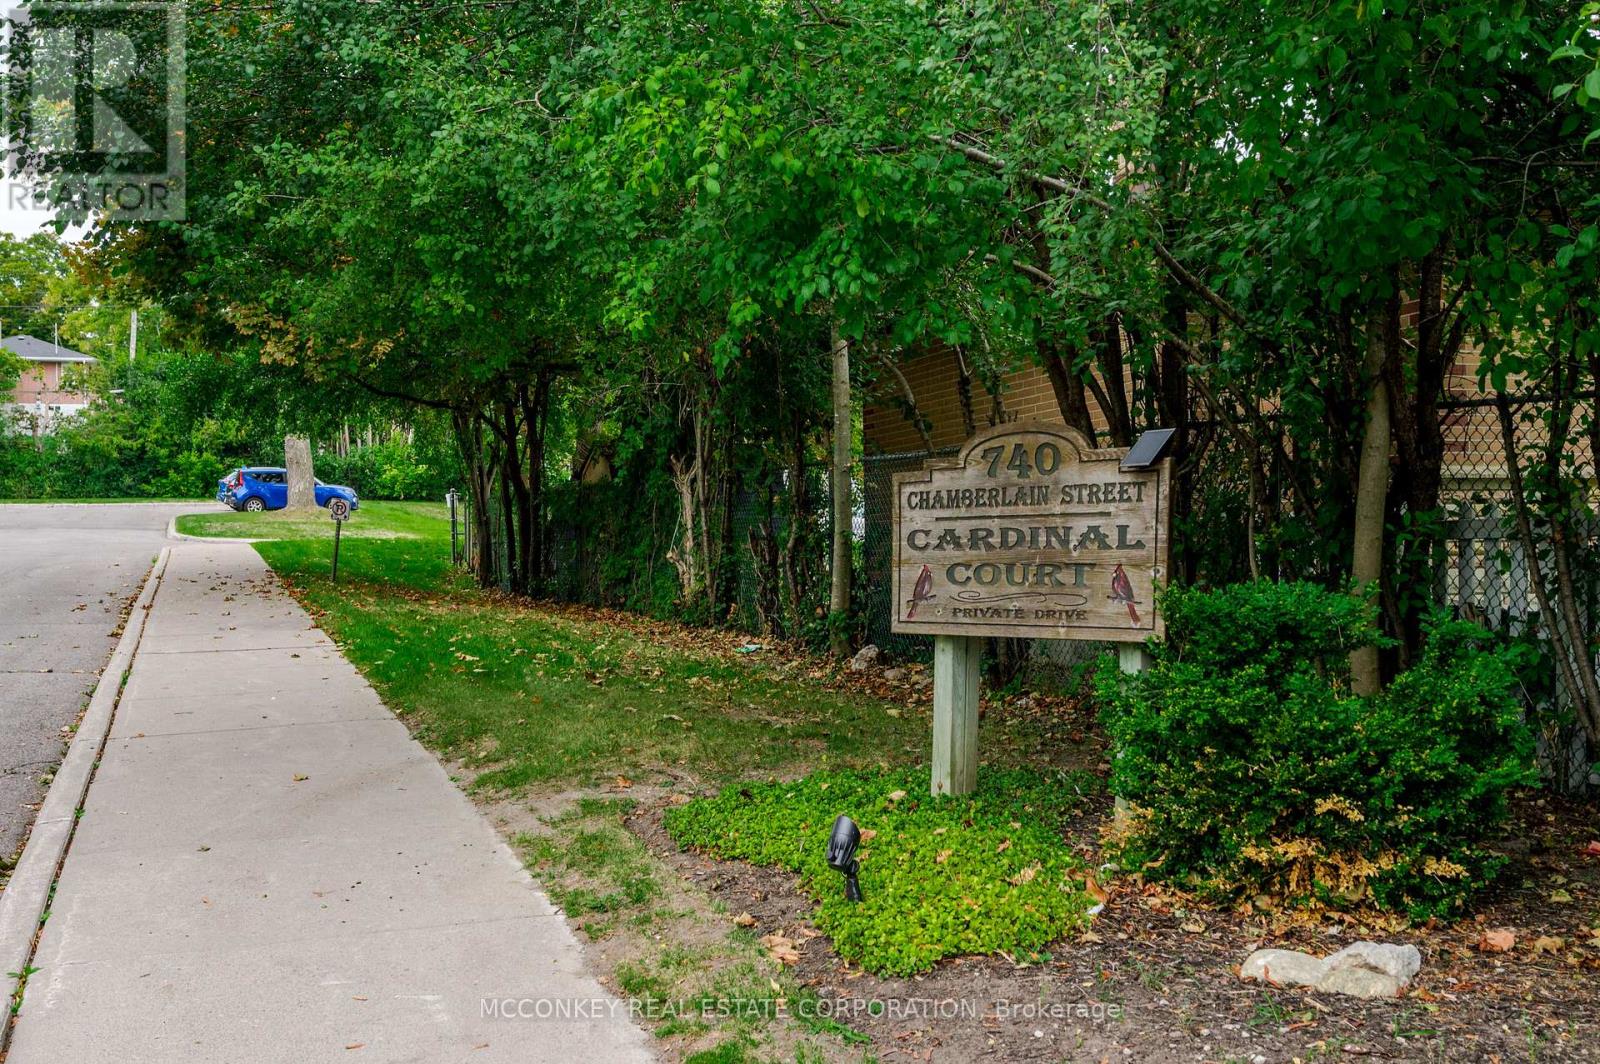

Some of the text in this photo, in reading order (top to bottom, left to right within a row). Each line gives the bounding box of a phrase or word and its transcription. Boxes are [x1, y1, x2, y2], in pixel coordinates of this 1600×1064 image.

[981, 442, 1062, 479] 740
[907, 481, 1148, 511] CHAMBERLAIN STREET
[906, 525, 1147, 551] CARDINAL
[946, 563, 1097, 588] COURT
[952, 607, 1089, 621] PRIVATE DRIVE
